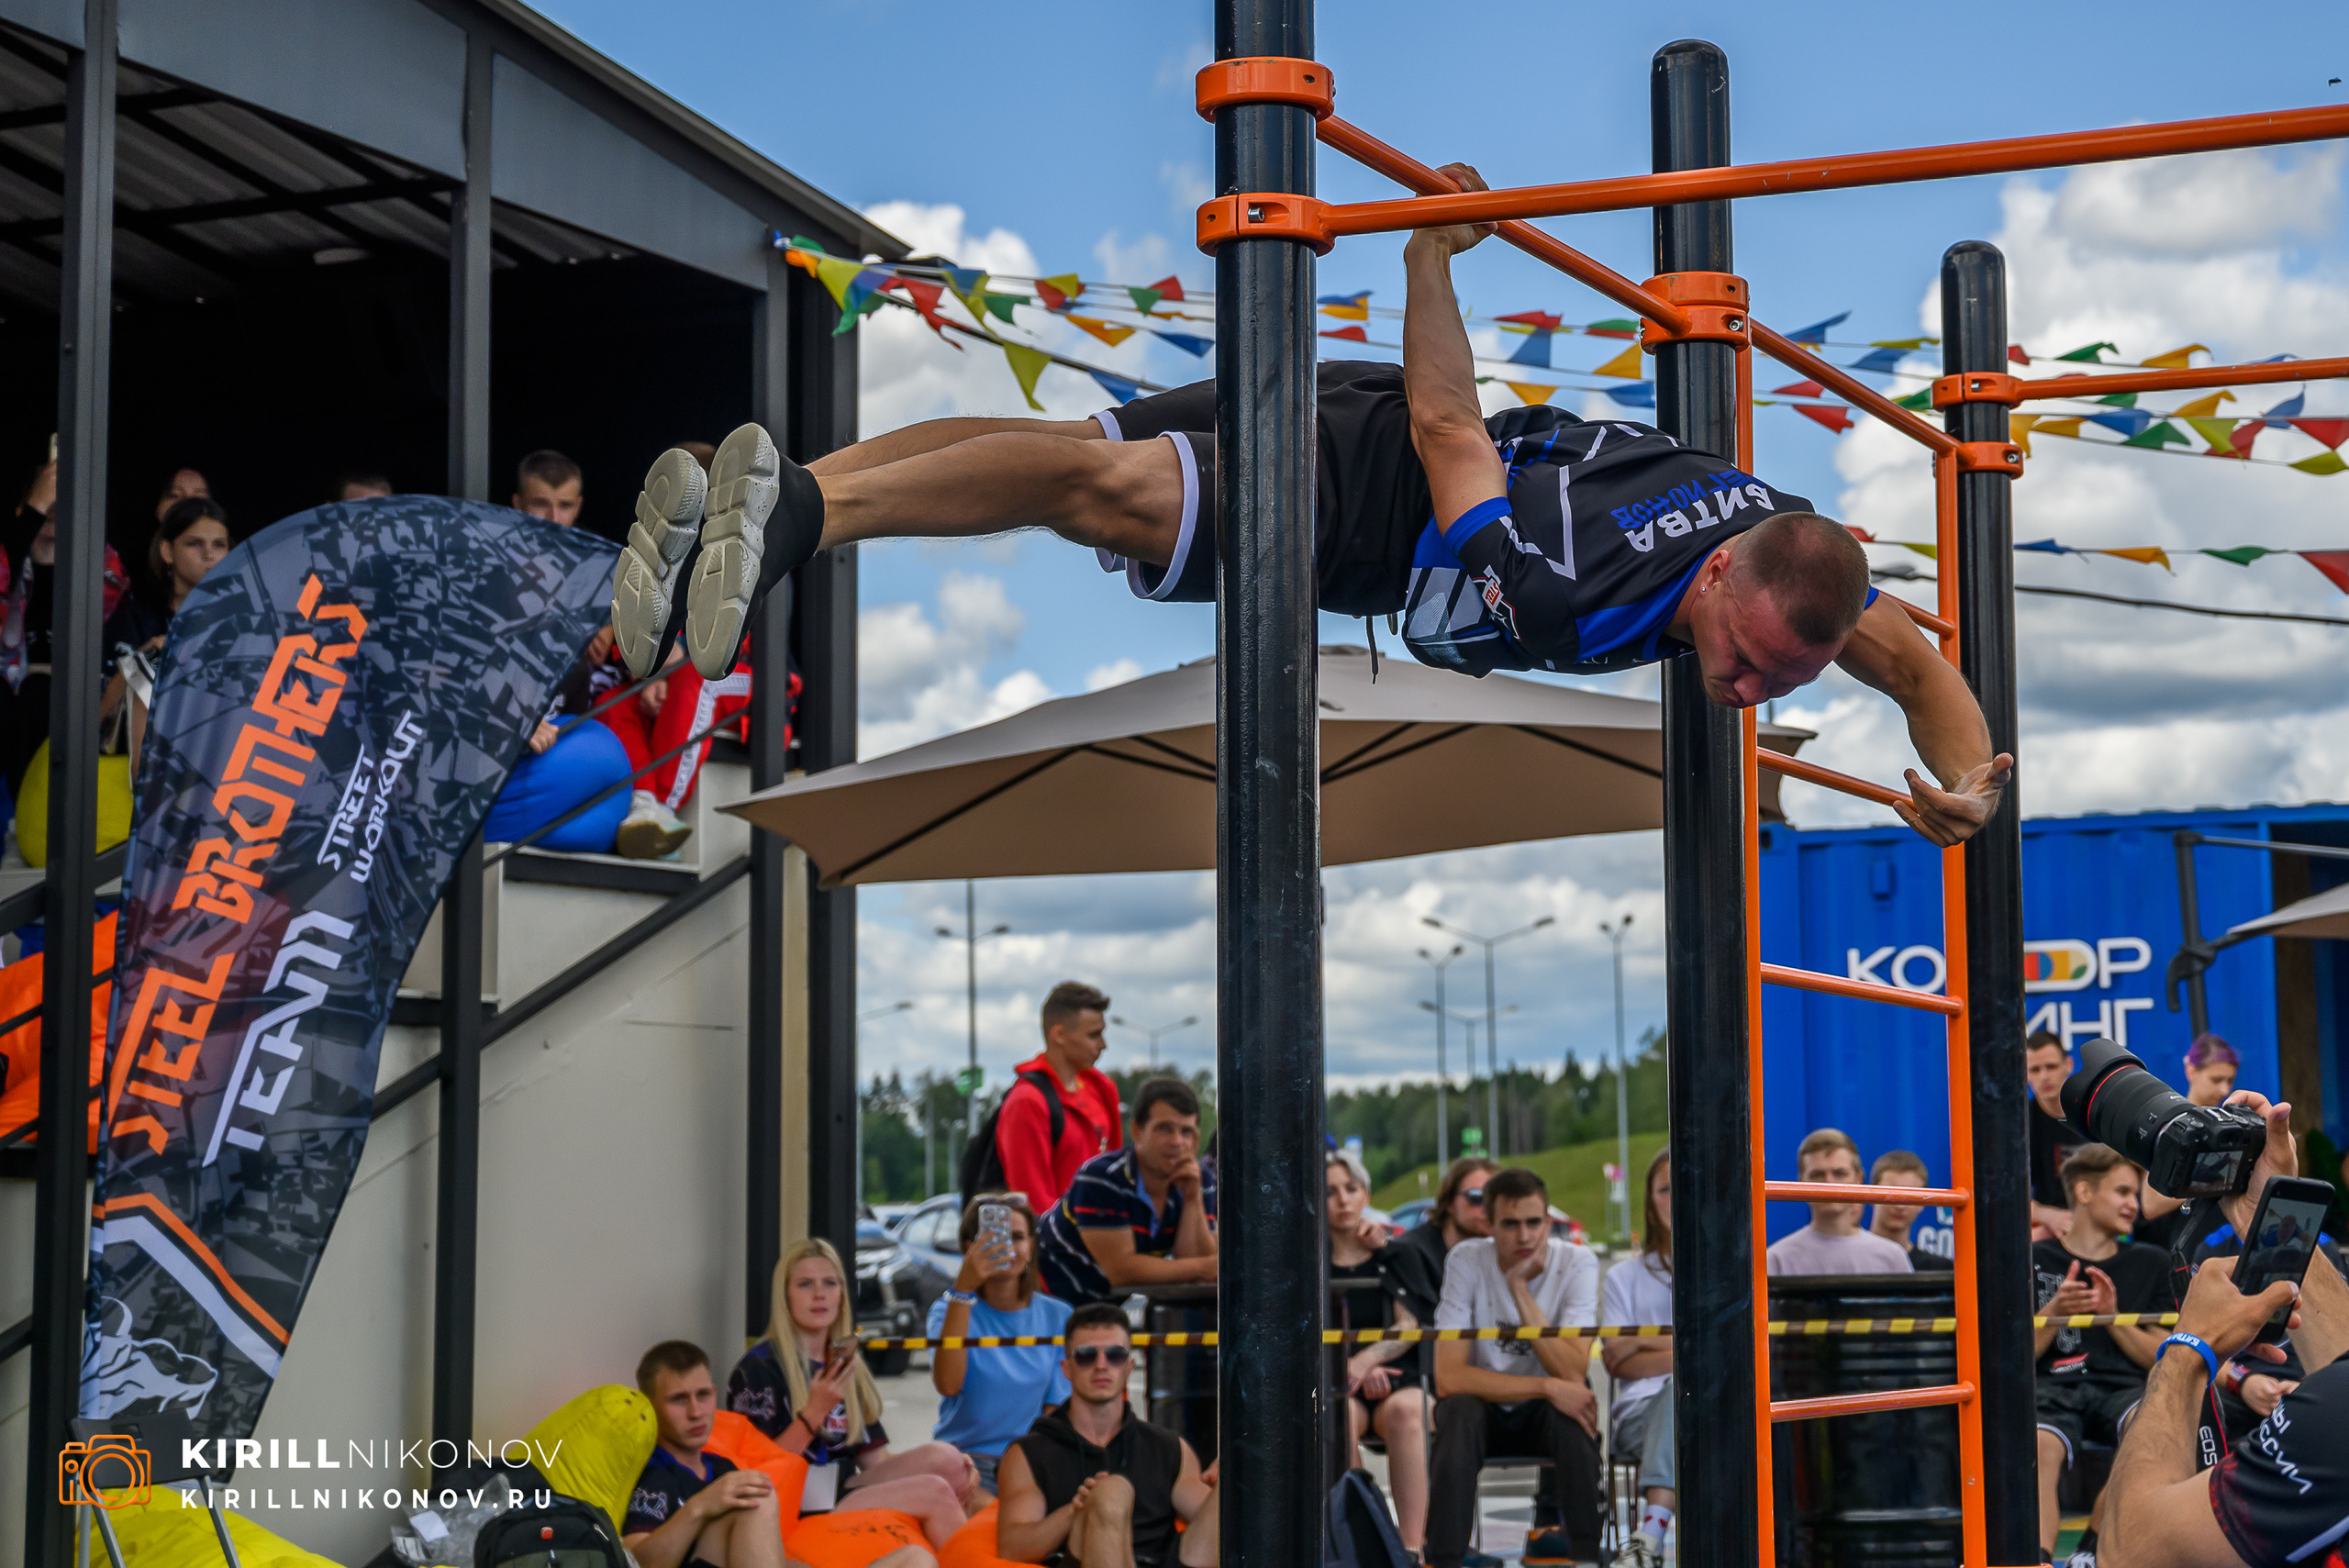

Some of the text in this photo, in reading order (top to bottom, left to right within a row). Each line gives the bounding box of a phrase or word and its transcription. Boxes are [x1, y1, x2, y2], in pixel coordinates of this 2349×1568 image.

[1624, 483, 1776, 552] БИТВА
[108, 573, 368, 1155] STEEL BROTHERS
[317, 742, 374, 872] STREET
[350, 708, 423, 884] WORKOUT
[202, 909, 354, 1168] TEAM
[2199, 1425, 2218, 1466] EOS
